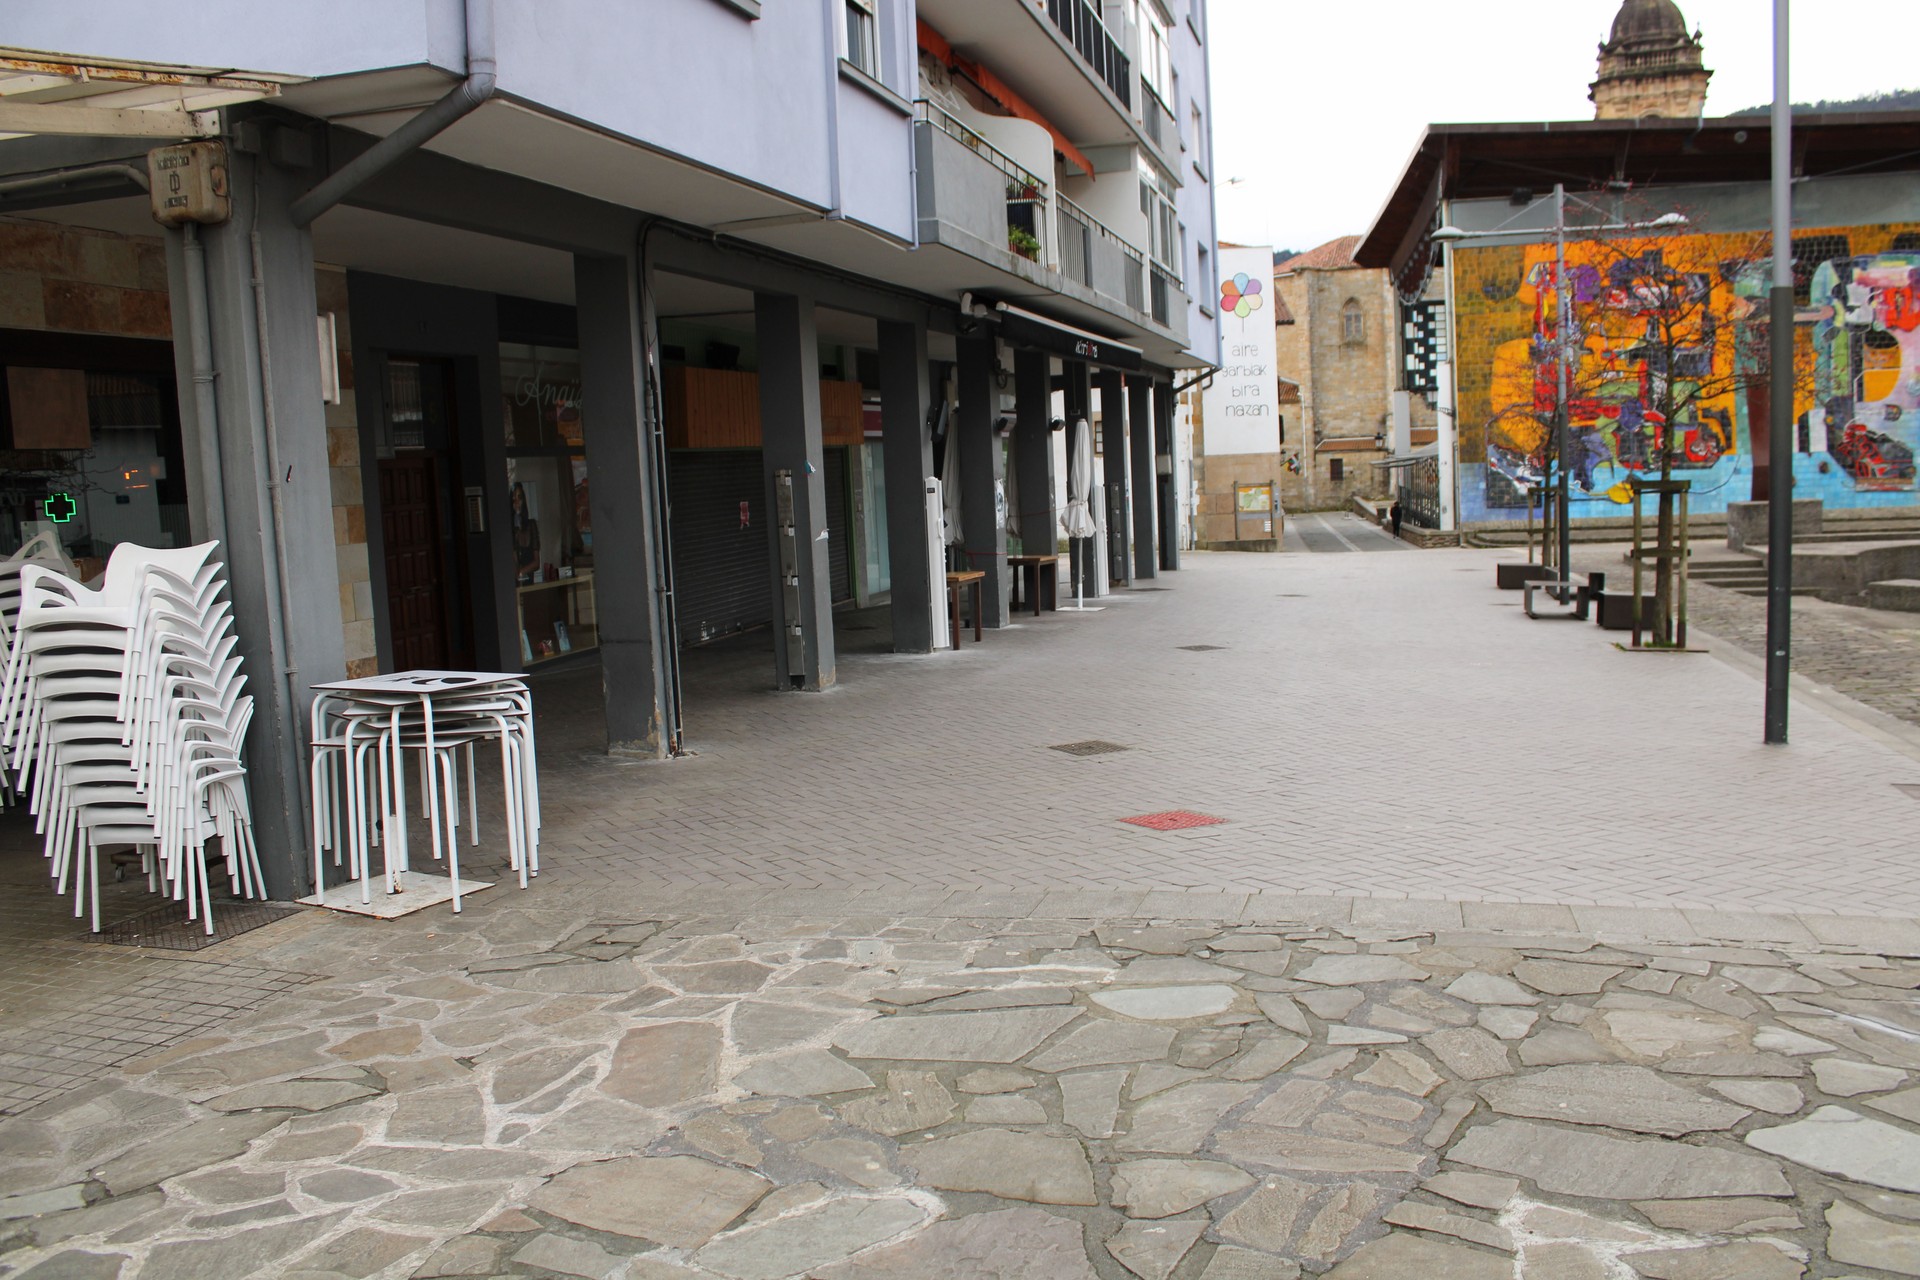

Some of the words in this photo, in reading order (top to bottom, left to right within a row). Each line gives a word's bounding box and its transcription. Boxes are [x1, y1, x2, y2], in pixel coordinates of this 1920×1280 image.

[1231, 343, 1258, 357] aire
[1222, 363, 1267, 377] garbiak
[1231, 384, 1260, 398] bira
[1225, 403, 1269, 416] nazan
